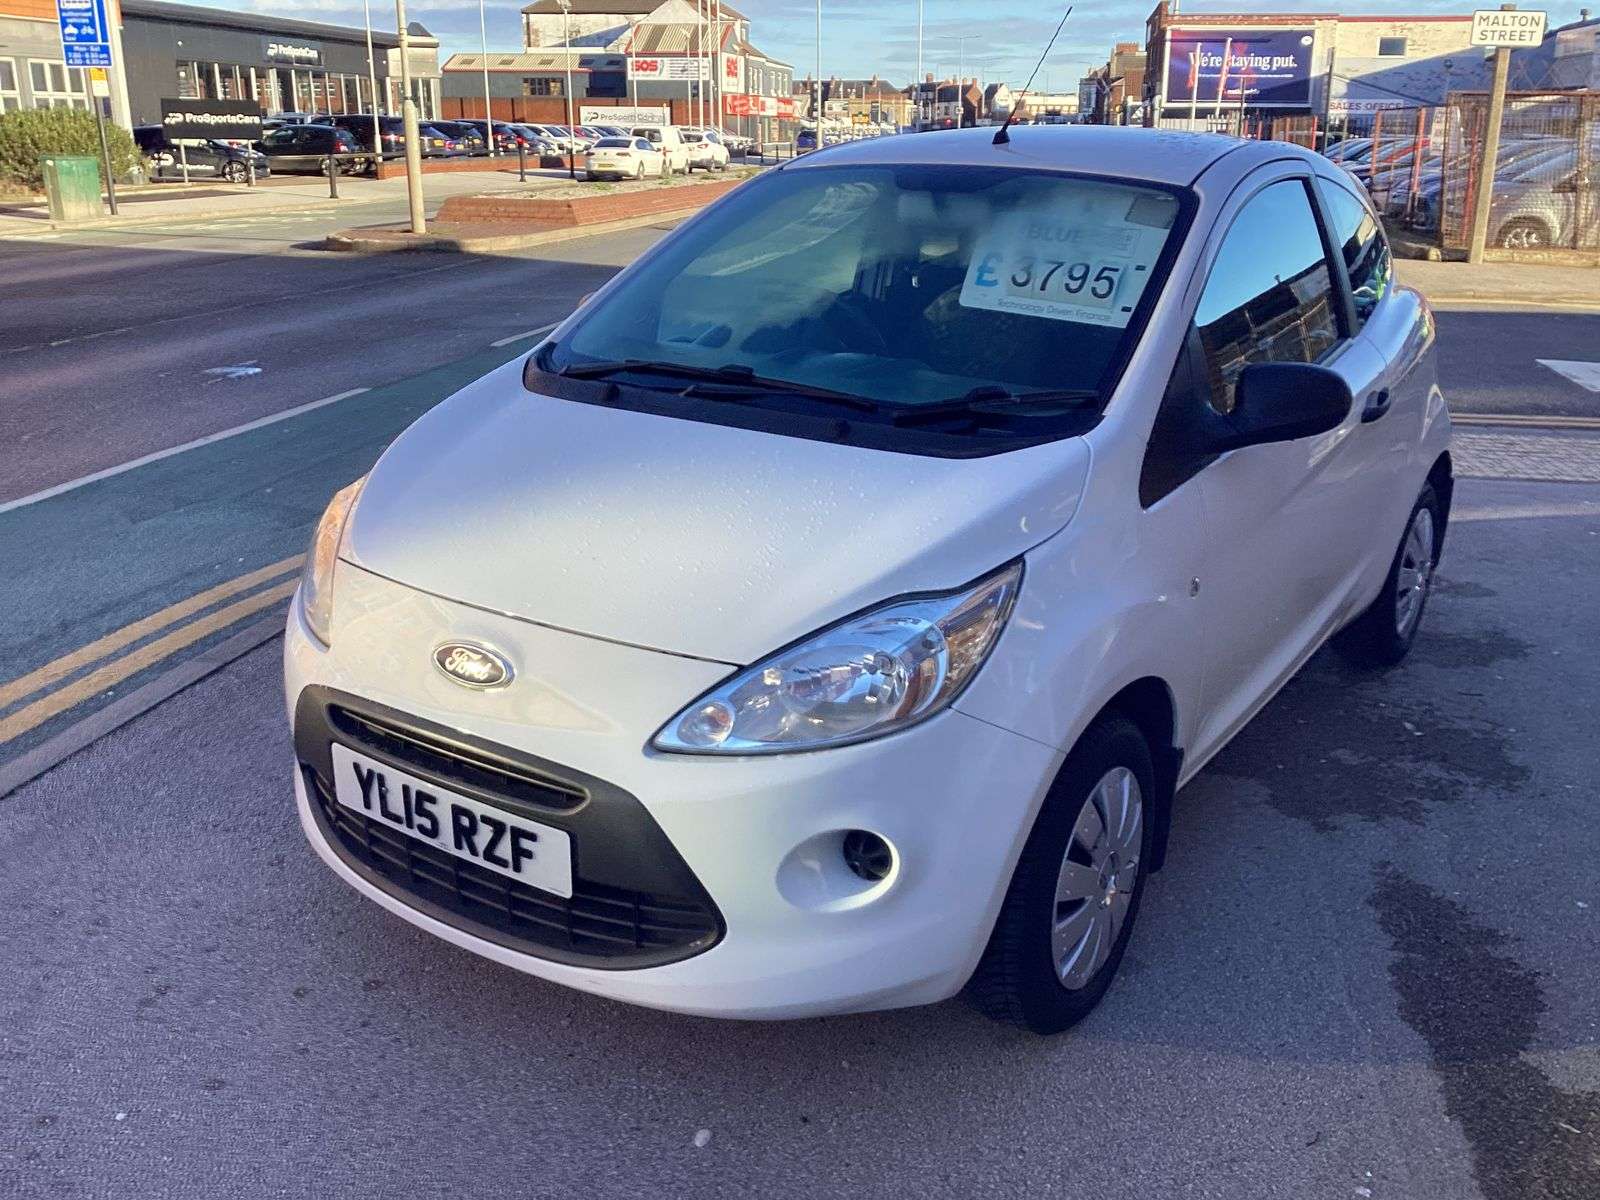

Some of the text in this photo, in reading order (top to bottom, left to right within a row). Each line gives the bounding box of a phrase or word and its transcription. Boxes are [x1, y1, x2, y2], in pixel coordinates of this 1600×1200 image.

[1478, 15, 1541, 27] MALTON
[1480, 30, 1537, 41] STREET
[631, 60, 658, 72] SOS
[1273, 54, 1298, 70] put.
[1329, 102, 1402, 111] SALES OFFICE
[185, 112, 260, 125] ProSportsCars
[445, 647, 492, 680] Ford
[352, 761, 538, 873] YL15 RZF
